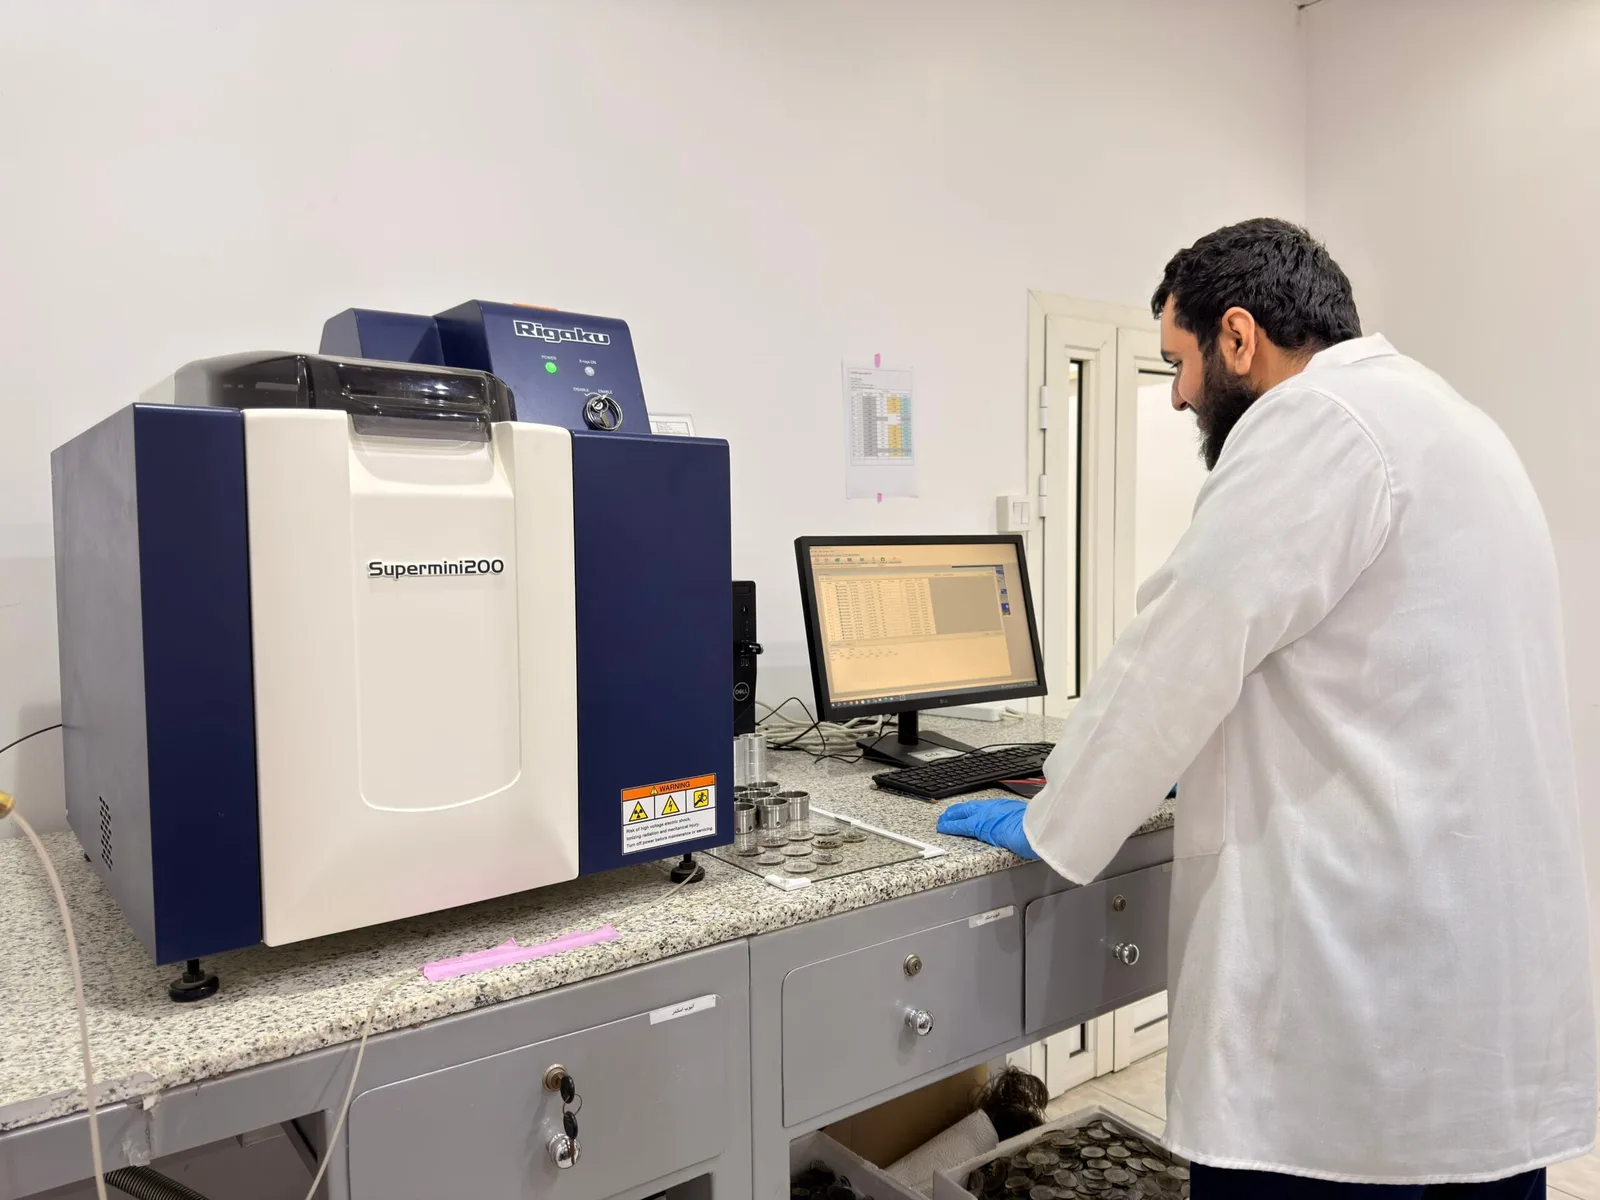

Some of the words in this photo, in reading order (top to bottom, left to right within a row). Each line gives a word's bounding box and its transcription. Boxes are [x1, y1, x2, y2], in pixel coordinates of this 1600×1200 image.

[513, 320, 610, 345] Rigaku
[368, 560, 504, 579] Supermini200
[660, 781, 690, 792] WARNING
[668, 831, 691, 839] maintenance
